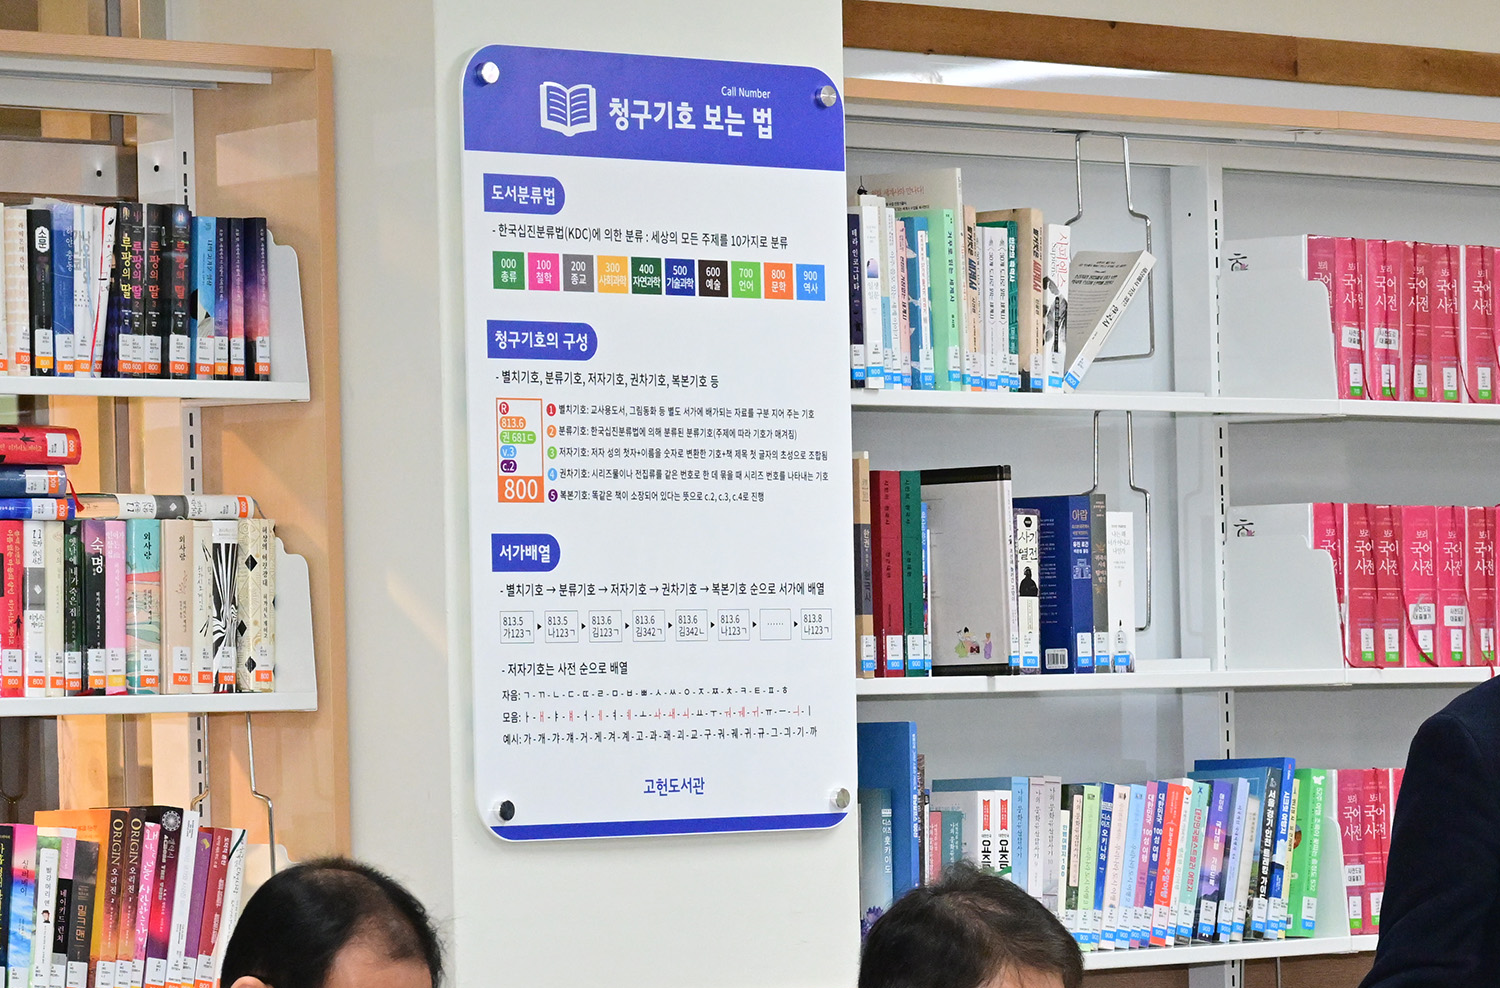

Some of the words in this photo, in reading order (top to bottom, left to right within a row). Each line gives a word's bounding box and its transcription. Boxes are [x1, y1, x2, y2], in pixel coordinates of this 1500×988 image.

[721, 85, 736, 97] Call
[738, 87, 771, 99] Number
[609, 97, 696, 130] 청구기호
[703, 104, 746, 138] 보는
[753, 106, 773, 140] 법
[491, 185, 556, 206] 도서분류법
[38, 229, 48, 249] 소문
[498, 223, 601, 243] 한국십진분류법(KDC)에
[604, 228, 623, 244] 의한
[625, 229, 643, 244] 분류
[651, 230, 679, 246] 세상의
[681, 231, 699, 247] 모든
[702, 232, 728, 249] 주제를
[731, 233, 768, 249] 10가지로
[771, 235, 789, 251] 분류
[121, 236, 131, 280] 루팡의
[148, 241, 160, 280] 루팡의
[501, 257, 517, 270] 000
[536, 259, 552, 271] 100
[571, 260, 587, 272] 200
[605, 262, 621, 273] 300
[638, 264, 655, 275] 400
[672, 265, 688, 276] 500
[705, 266, 721, 277] 600
[738, 267, 754, 278] 700
[500, 270, 518, 284] 총류
[535, 271, 553, 285] 철학
[570, 272, 588, 286] 종교
[598, 273, 628, 288] 사회과학
[632, 275, 662, 289] 자연과학
[771, 269, 786, 280] 800
[803, 270, 818, 281] 900
[666, 275, 695, 290] 기술과학
[705, 277, 722, 292] 예술
[738, 278, 755, 293] 언어
[771, 279, 787, 295] 문학
[802, 281, 819, 296] 역사
[121, 283, 131, 299] 딸
[148, 284, 160, 299] 딸
[495, 330, 559, 349] 청구기호의
[563, 332, 588, 352] 구성
[148, 363, 158, 371] 800
[502, 370, 543, 386] 별치기호,
[545, 371, 586, 387] 분류기호,
[588, 372, 628, 388] 저자기호,
[630, 373, 670, 389] 권차기호,
[672, 374, 707, 388] 복본기호
[710, 375, 719, 388] 등
[558, 404, 590, 415] 별치기호:
[591, 405, 628, 417] 교사용도서,
[629, 405, 657, 417] 그림동화
[659, 406, 665, 416] 등
[668, 406, 681, 416] 별도
[683, 407, 704, 417] 서가에
[705, 407, 732, 418] 배가되는
[734, 408, 754, 418] 자료를
[756, 408, 769, 419] 구분
[771, 408, 785, 419] 지어
[786, 409, 800, 419] 주는
[801, 409, 815, 419] 기호
[501, 418, 525, 429] 813.6
[502, 449, 515, 458] v.3
[502, 462, 515, 471] c.2
[504, 478, 539, 500] 800
[1416, 530, 1429, 540] 보리
[143, 532, 152, 560] 외사랑
[500, 544, 550, 563] 서가배열
[1410, 541, 1433, 561] 국어
[90, 536, 104, 574] 숙명
[1410, 558, 1435, 578] 사전
[506, 583, 544, 597] 별치기호
[559, 583, 596, 597] 분류기호
[610, 582, 647, 597] 저자기호
[661, 582, 697, 597] 권차기호
[711, 582, 747, 596] 복본기호
[750, 582, 776, 596] 순으로
[779, 582, 805, 596] 서가에
[807, 582, 825, 596] 배열
[503, 616, 524, 626] 813.5
[547, 616, 568, 625] 813.5
[592, 615, 612, 625] 813.6
[635, 615, 656, 625] 813.6
[678, 615, 698, 624] 813.6
[720, 615, 740, 624] 813.6
[803, 614, 823, 623] 813.8
[507, 662, 555, 677] 저자기호는
[558, 662, 577, 676] 사전
[579, 661, 607, 675] 순으로
[609, 660, 628, 675] 배열
[643, 776, 705, 796] 고헌도서관
[111, 818, 124, 867] ORIGIN
[129, 817, 142, 867] ORIGIN
